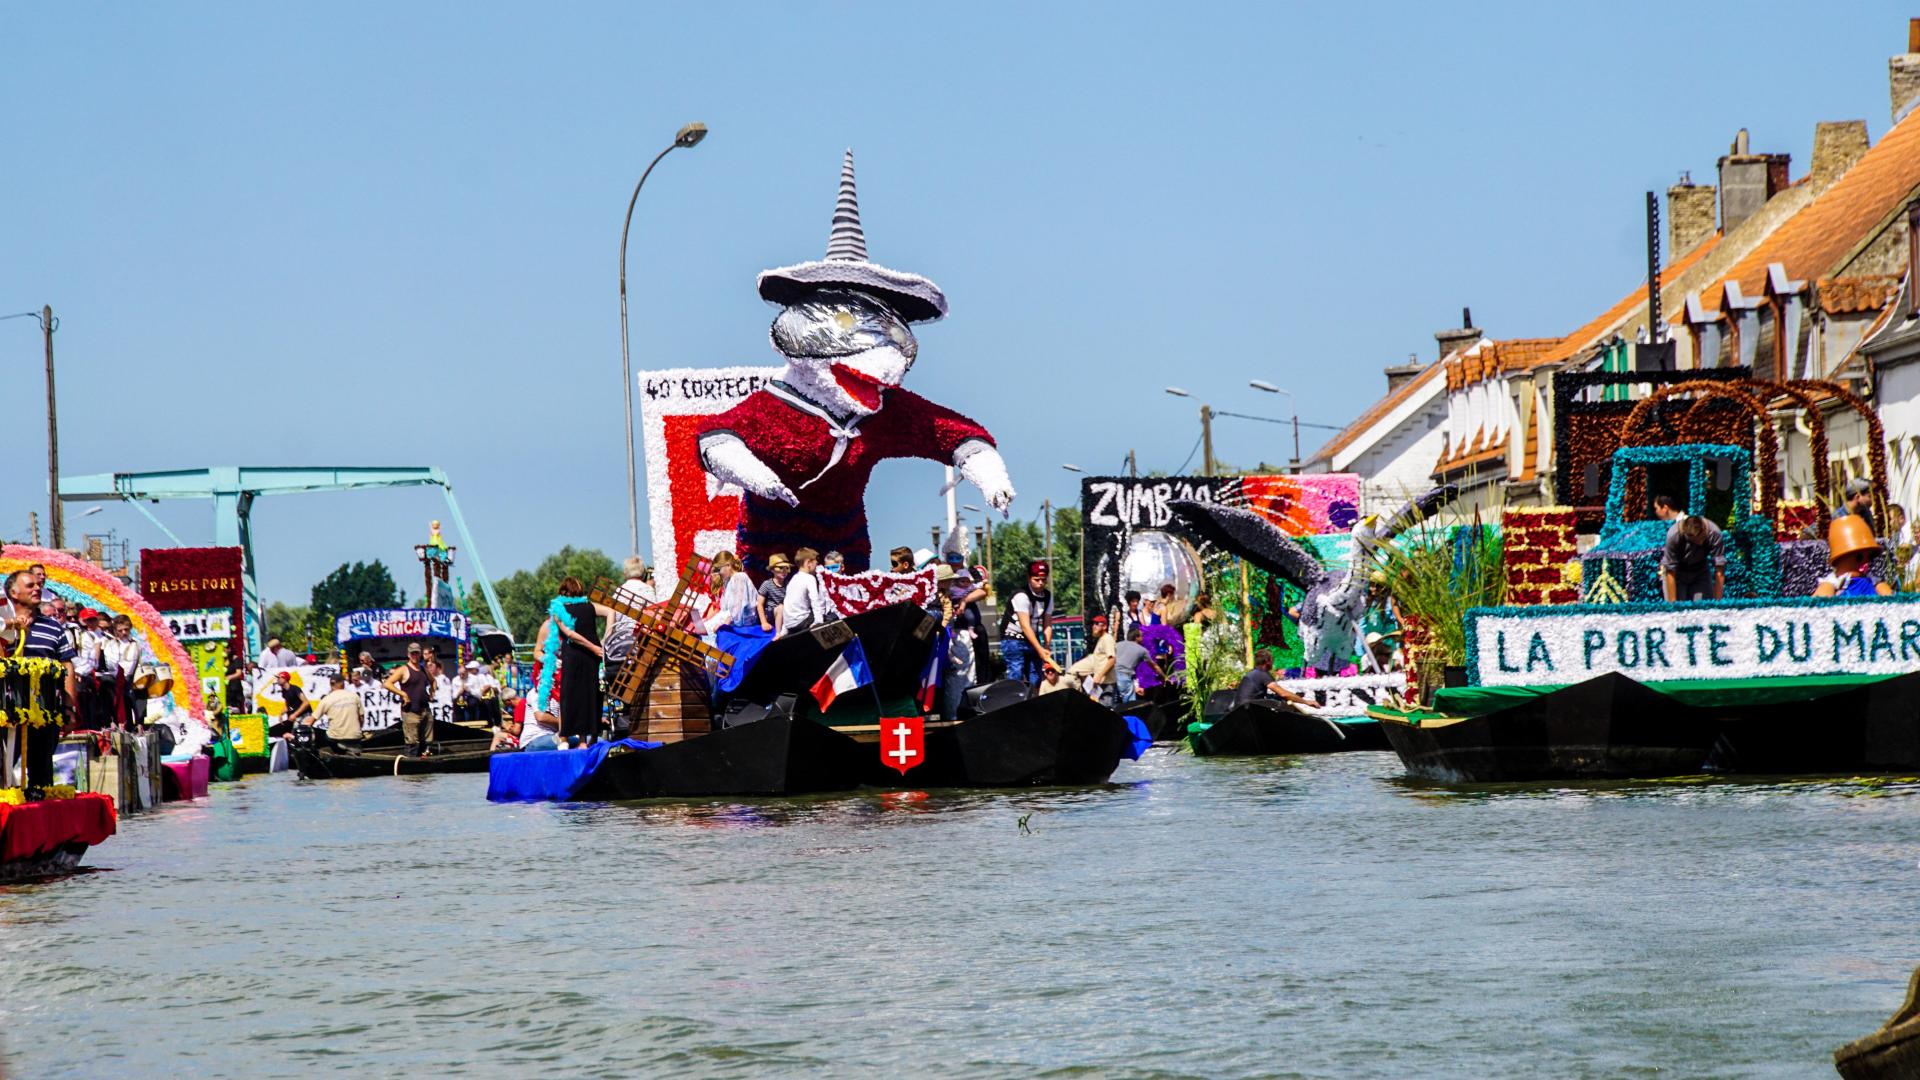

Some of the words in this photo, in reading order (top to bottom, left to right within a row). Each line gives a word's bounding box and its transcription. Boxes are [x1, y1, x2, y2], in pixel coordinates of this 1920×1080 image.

[380, 621, 423, 636] SIMCA
[1498, 630, 1555, 672] LA
[1583, 625, 1734, 670] PORTE
[1756, 621, 1812, 664] DU
[1833, 617, 1920, 664] MAR
